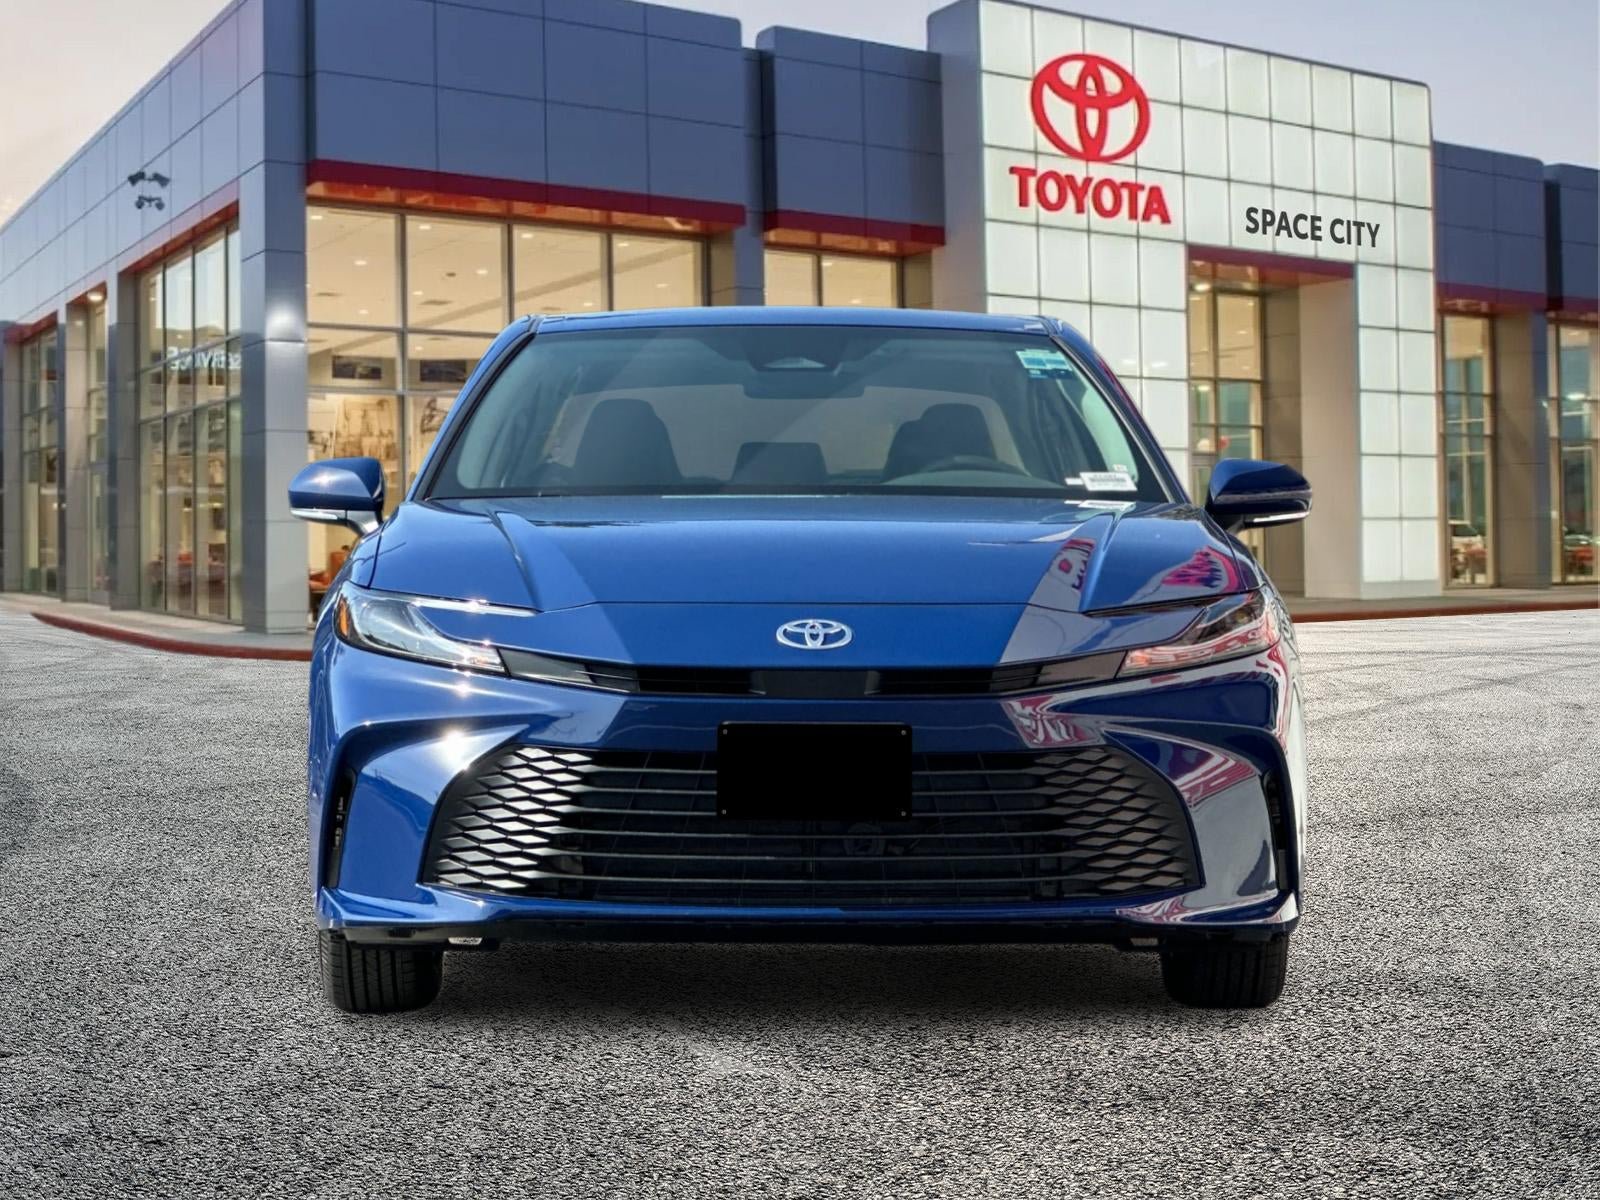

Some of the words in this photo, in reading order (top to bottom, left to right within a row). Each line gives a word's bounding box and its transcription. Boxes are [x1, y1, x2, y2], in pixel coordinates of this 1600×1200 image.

[1009, 166, 1171, 224] TOYOTA
[1245, 207, 1323, 241] SPACE
[1329, 219, 1381, 248] CITY
